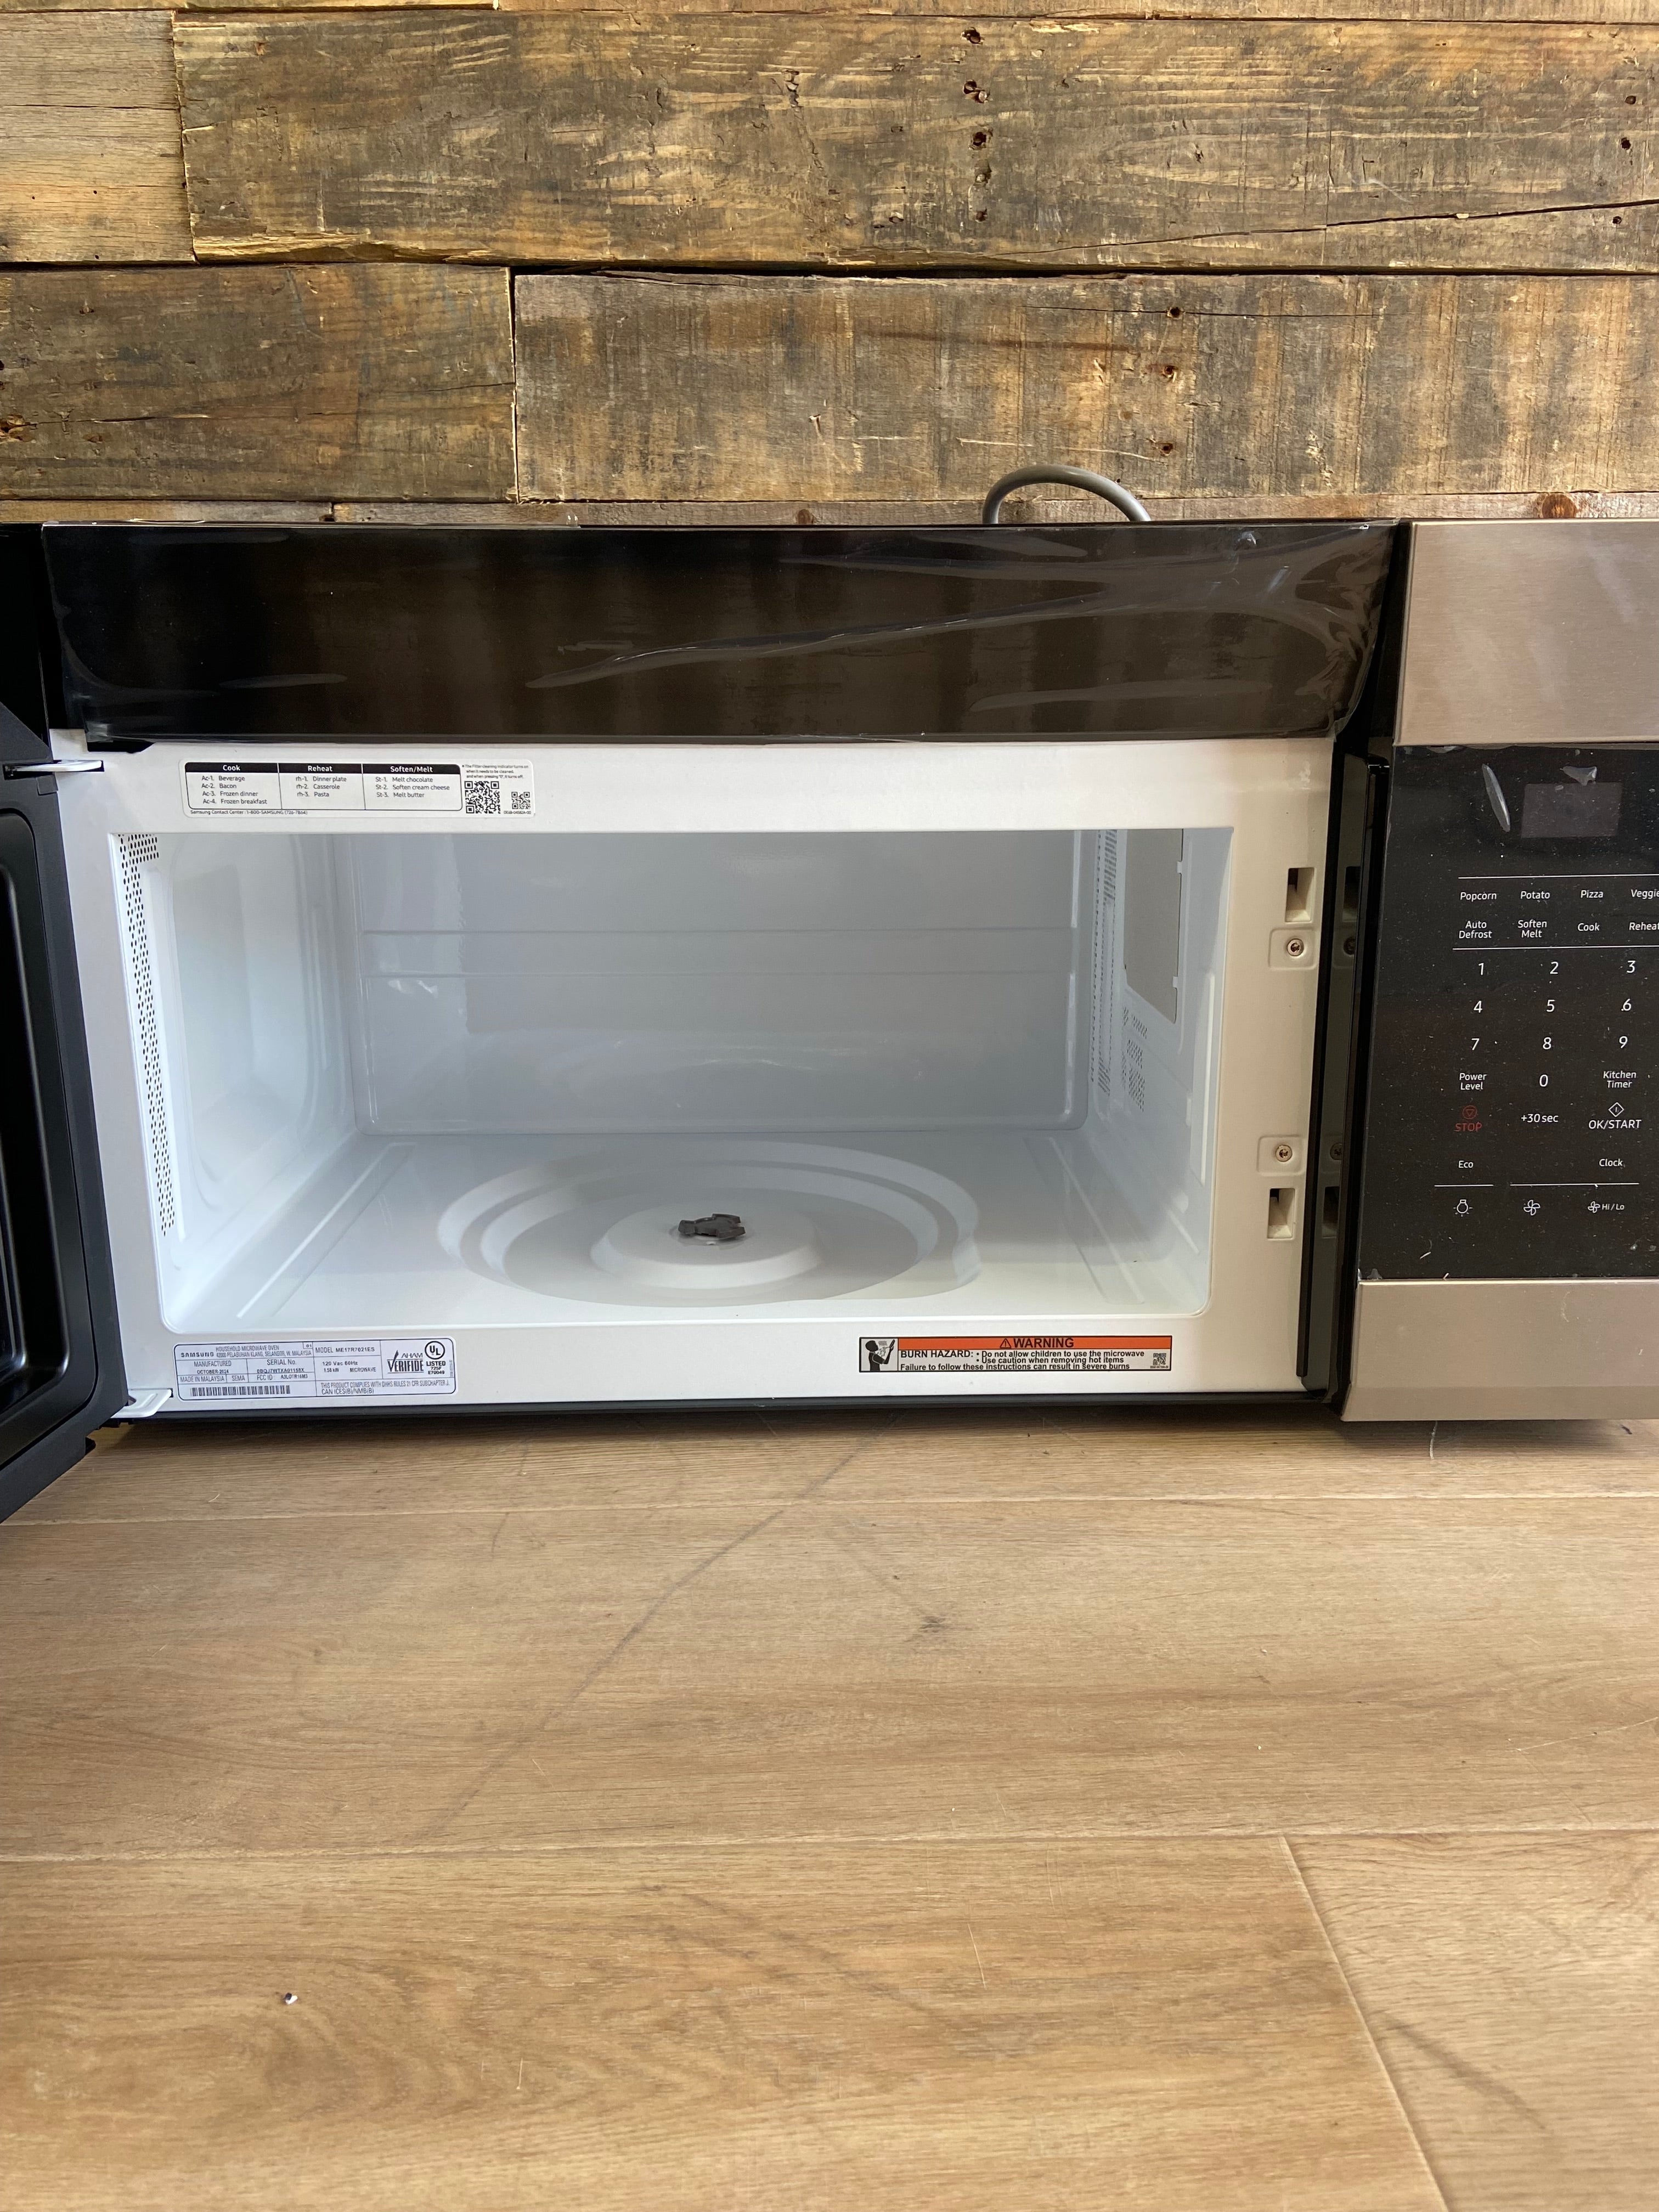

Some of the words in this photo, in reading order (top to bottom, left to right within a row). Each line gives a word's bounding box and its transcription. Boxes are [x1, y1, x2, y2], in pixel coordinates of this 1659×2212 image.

[1460, 891, 1497, 902] Popcorn
[1520, 890, 1550, 900] Potato
[1580, 889, 1604, 899] Pizza
[1465, 920, 1487, 929] Auto
[1517, 919, 1547, 928] Soften
[1577, 922, 1600, 932] Cook
[1459, 930, 1493, 939] Defrost
[1521, 929, 1543, 938] Melt
[1478, 962, 1485, 975] 1
[1549, 961, 1559, 974] 2
[1626, 960, 1636, 973] 3
[1473, 1000, 1483, 1013] 4
[1546, 999, 1555, 1012] 5
[1623, 998, 1632, 1012] 6
[1470, 1037, 1480, 1051] 7
[1542, 1036, 1552, 1050] 8
[1619, 1036, 1628, 1049] 9
[1459, 1073, 1487, 1081] Power
[1603, 1070, 1637, 1079] Kitchen
[1539, 1074, 1549, 1087] 0
[1606, 1080, 1633, 1088] Timer
[1460, 1082, 1483, 1091] Level
[1454, 1122, 1482, 1132] STOP
[1588, 1119, 1642, 1130] OK/START
[1458, 1160, 1474, 1169] Eco
[1599, 1158, 1623, 1167] Clock
[1013, 1338, 1074, 1348] WARNING
[387, 1358, 424, 1372] VERIFIDE
